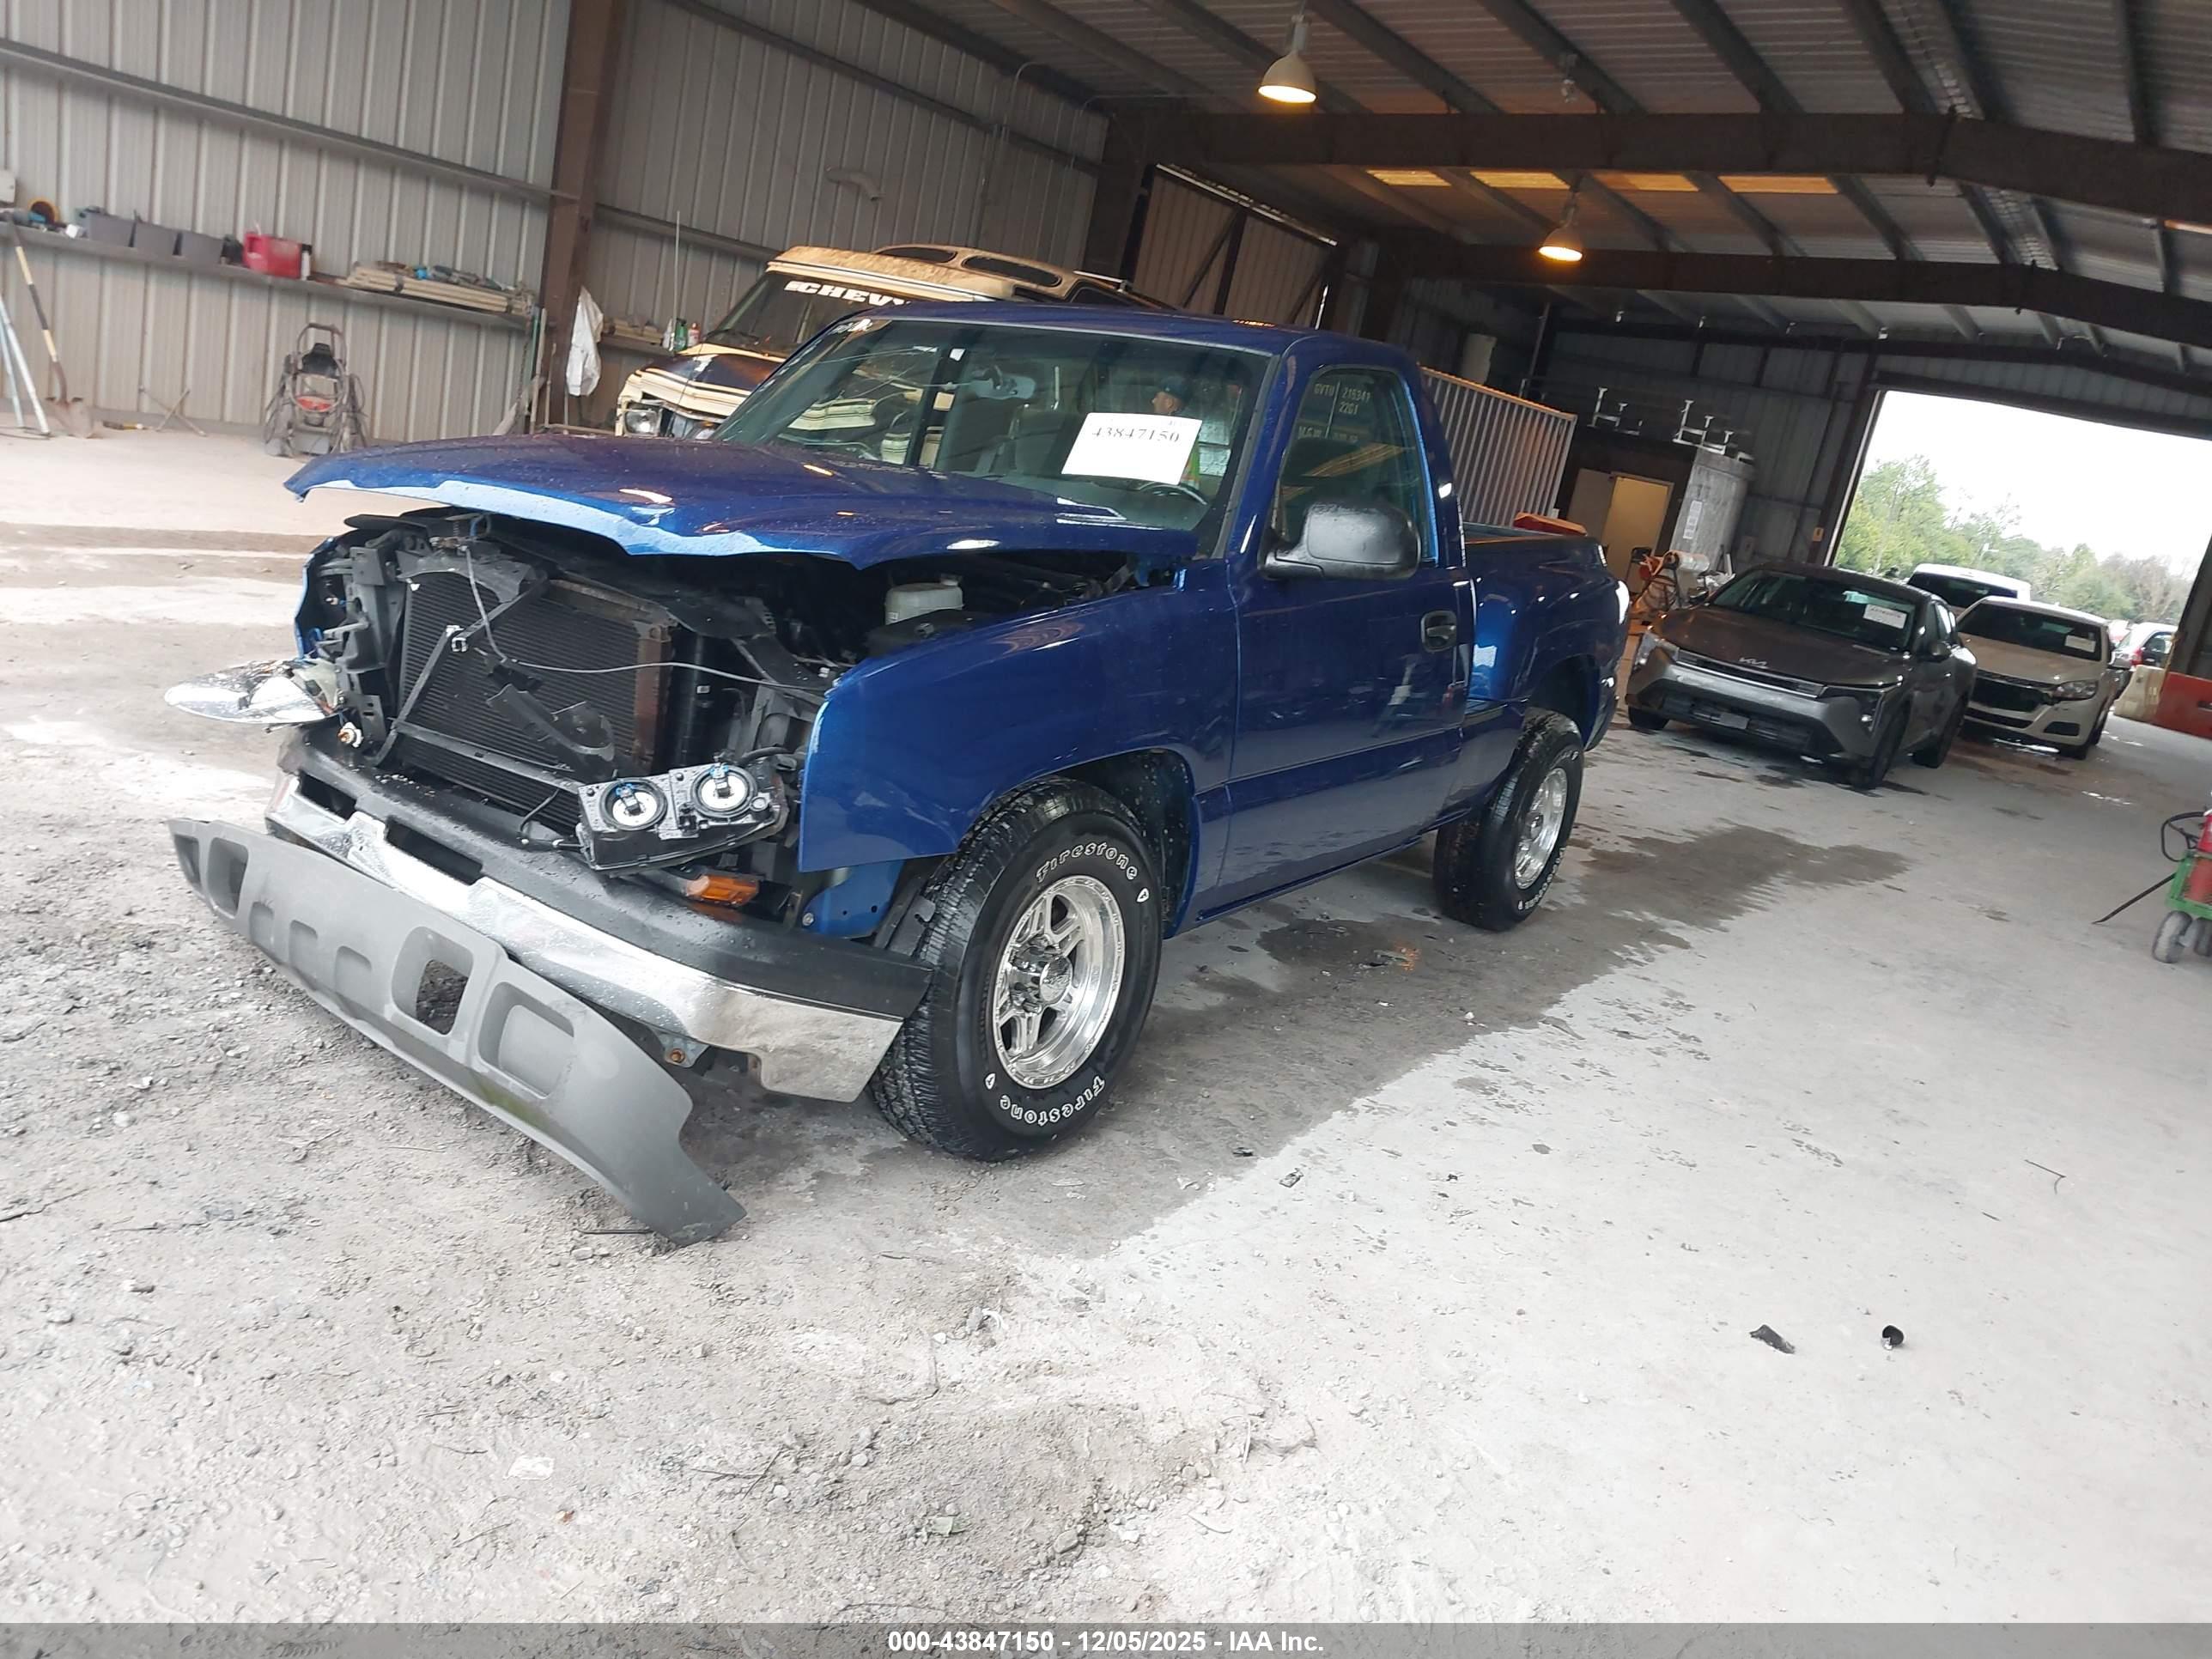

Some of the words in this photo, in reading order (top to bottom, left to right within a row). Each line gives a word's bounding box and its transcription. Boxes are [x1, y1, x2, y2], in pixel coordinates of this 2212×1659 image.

[1091, 427, 1180, 443] 43847150
[1036, 842, 1138, 884] Firestone
[1000, 1075, 1105, 1127] Firestone
